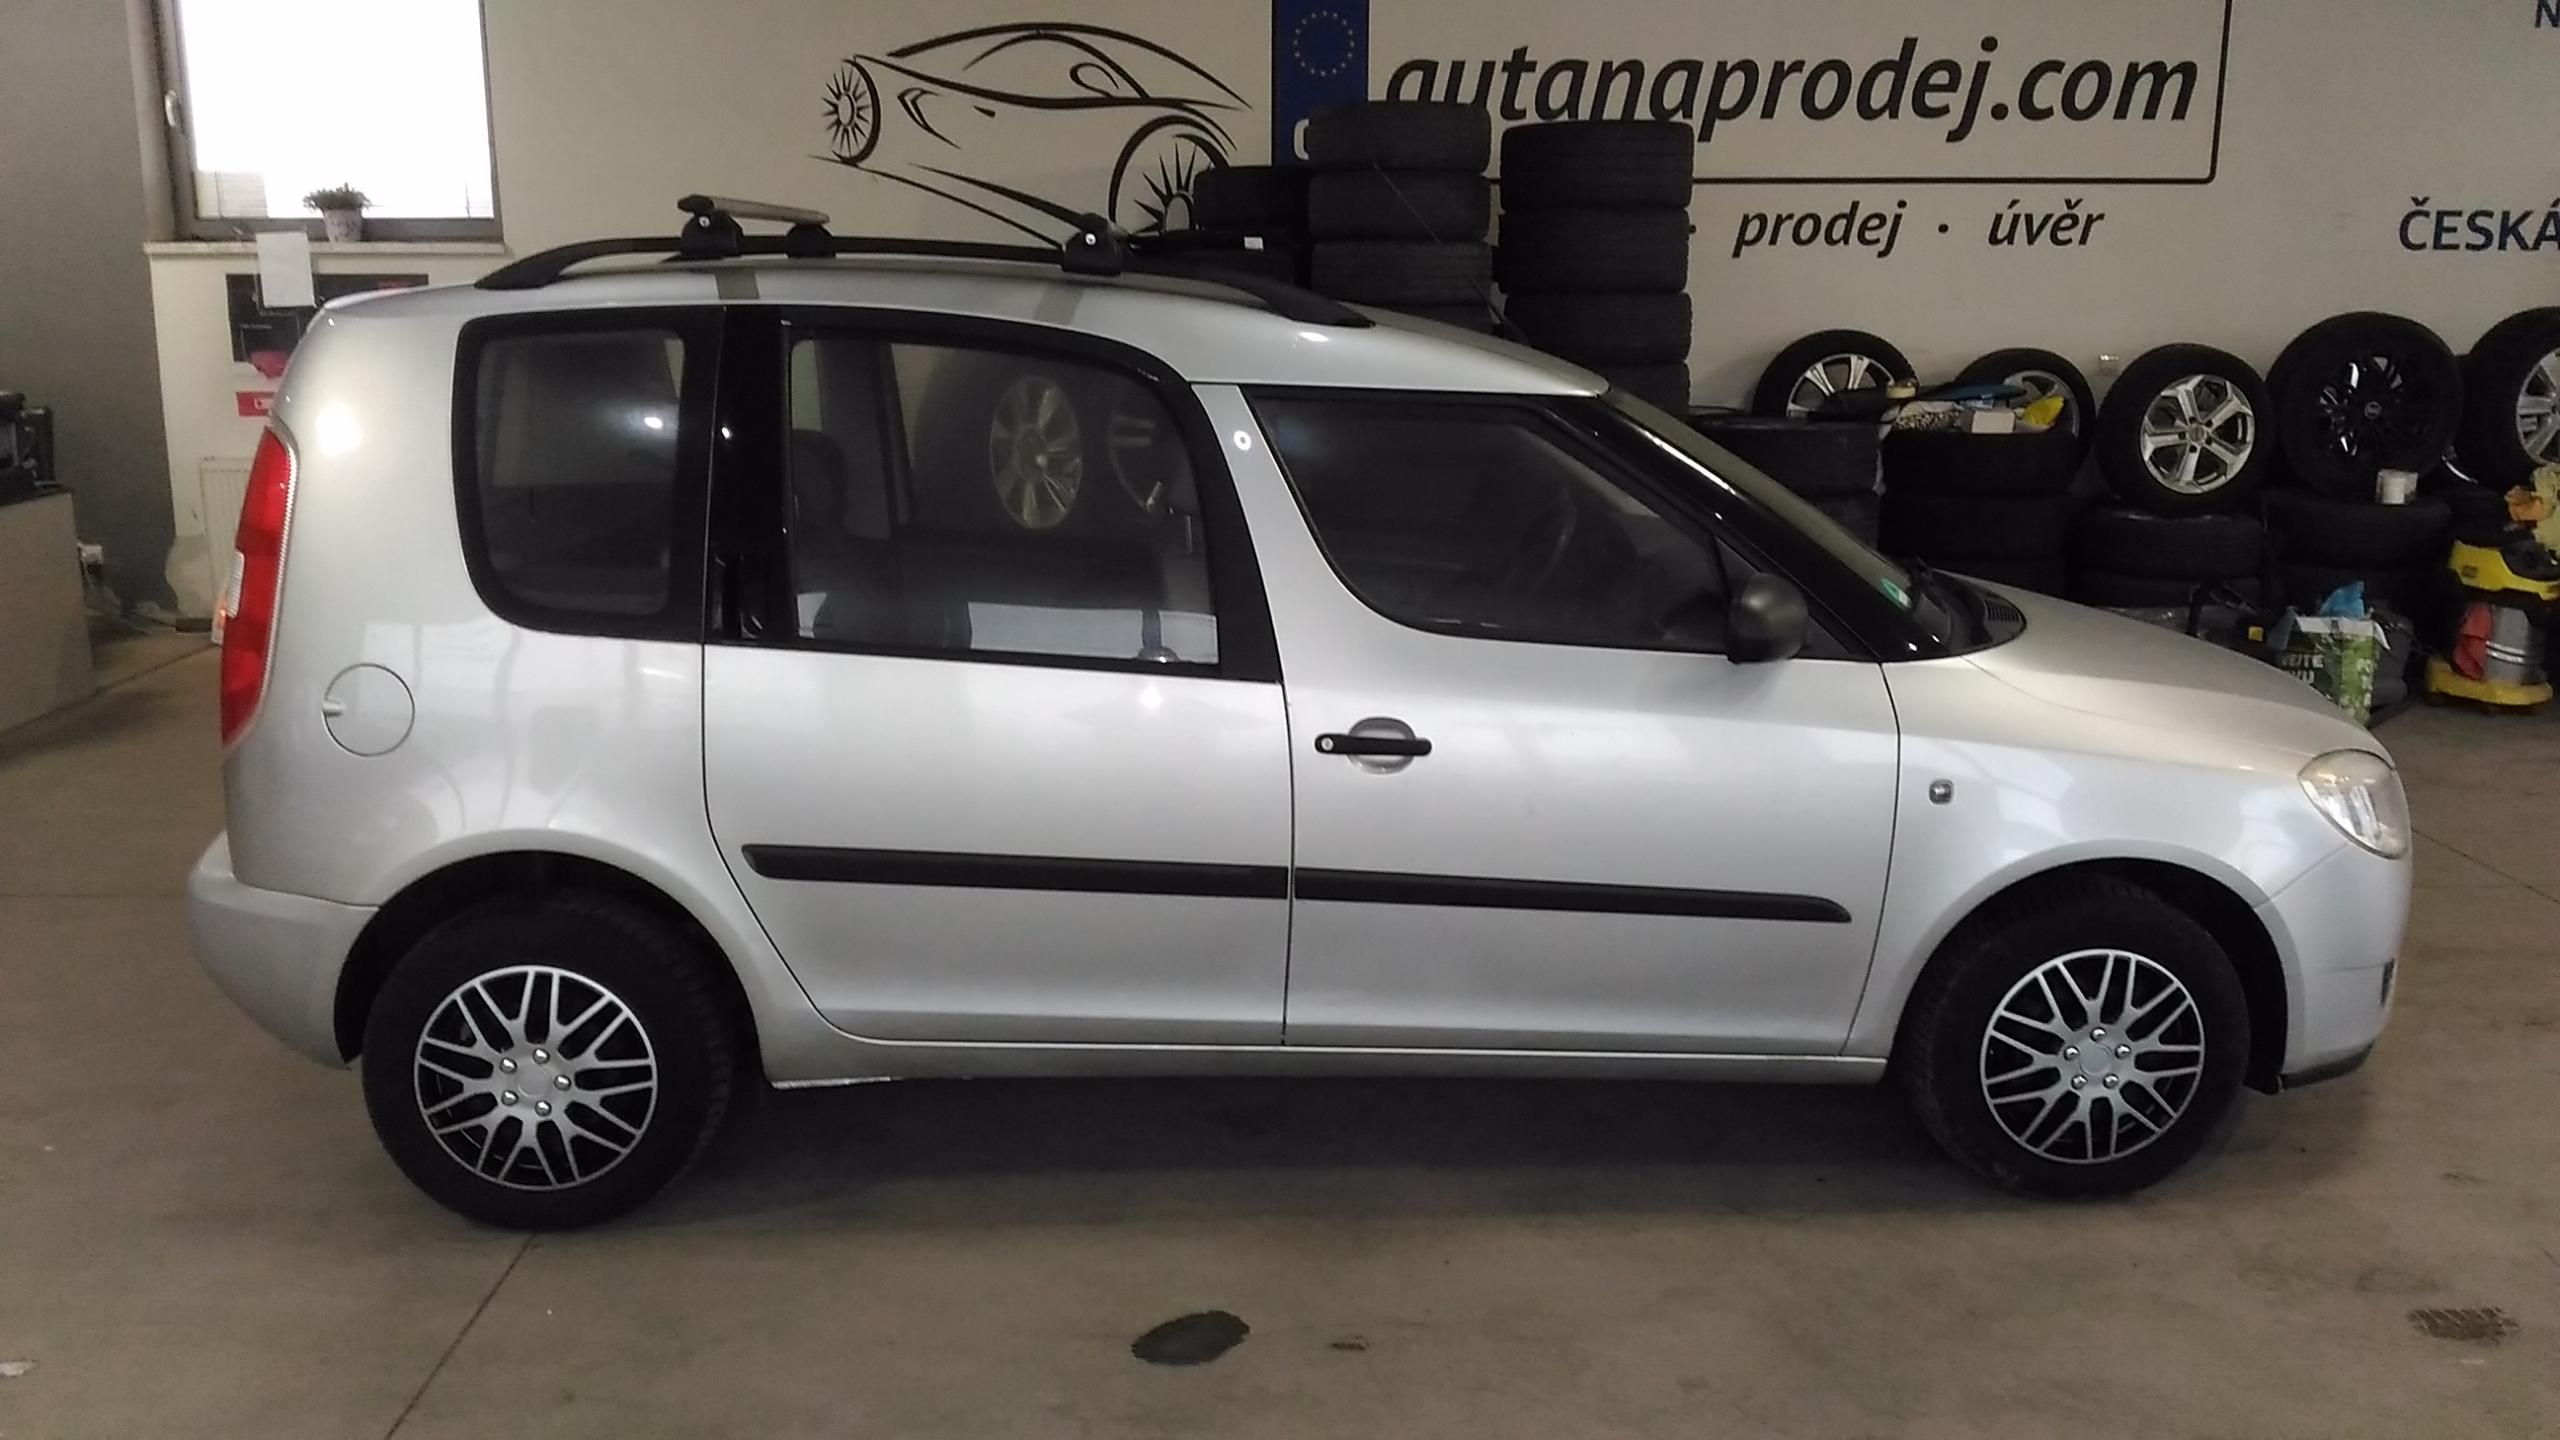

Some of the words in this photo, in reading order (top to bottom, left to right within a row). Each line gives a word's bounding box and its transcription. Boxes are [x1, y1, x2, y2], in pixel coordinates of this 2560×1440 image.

[1386, 36, 2198, 144] autanaprodej.com
[1731, 199, 1907, 259] prodej
[1987, 198, 2105, 246] úvěr
[2398, 196, 2560, 252] ČESKÁ
